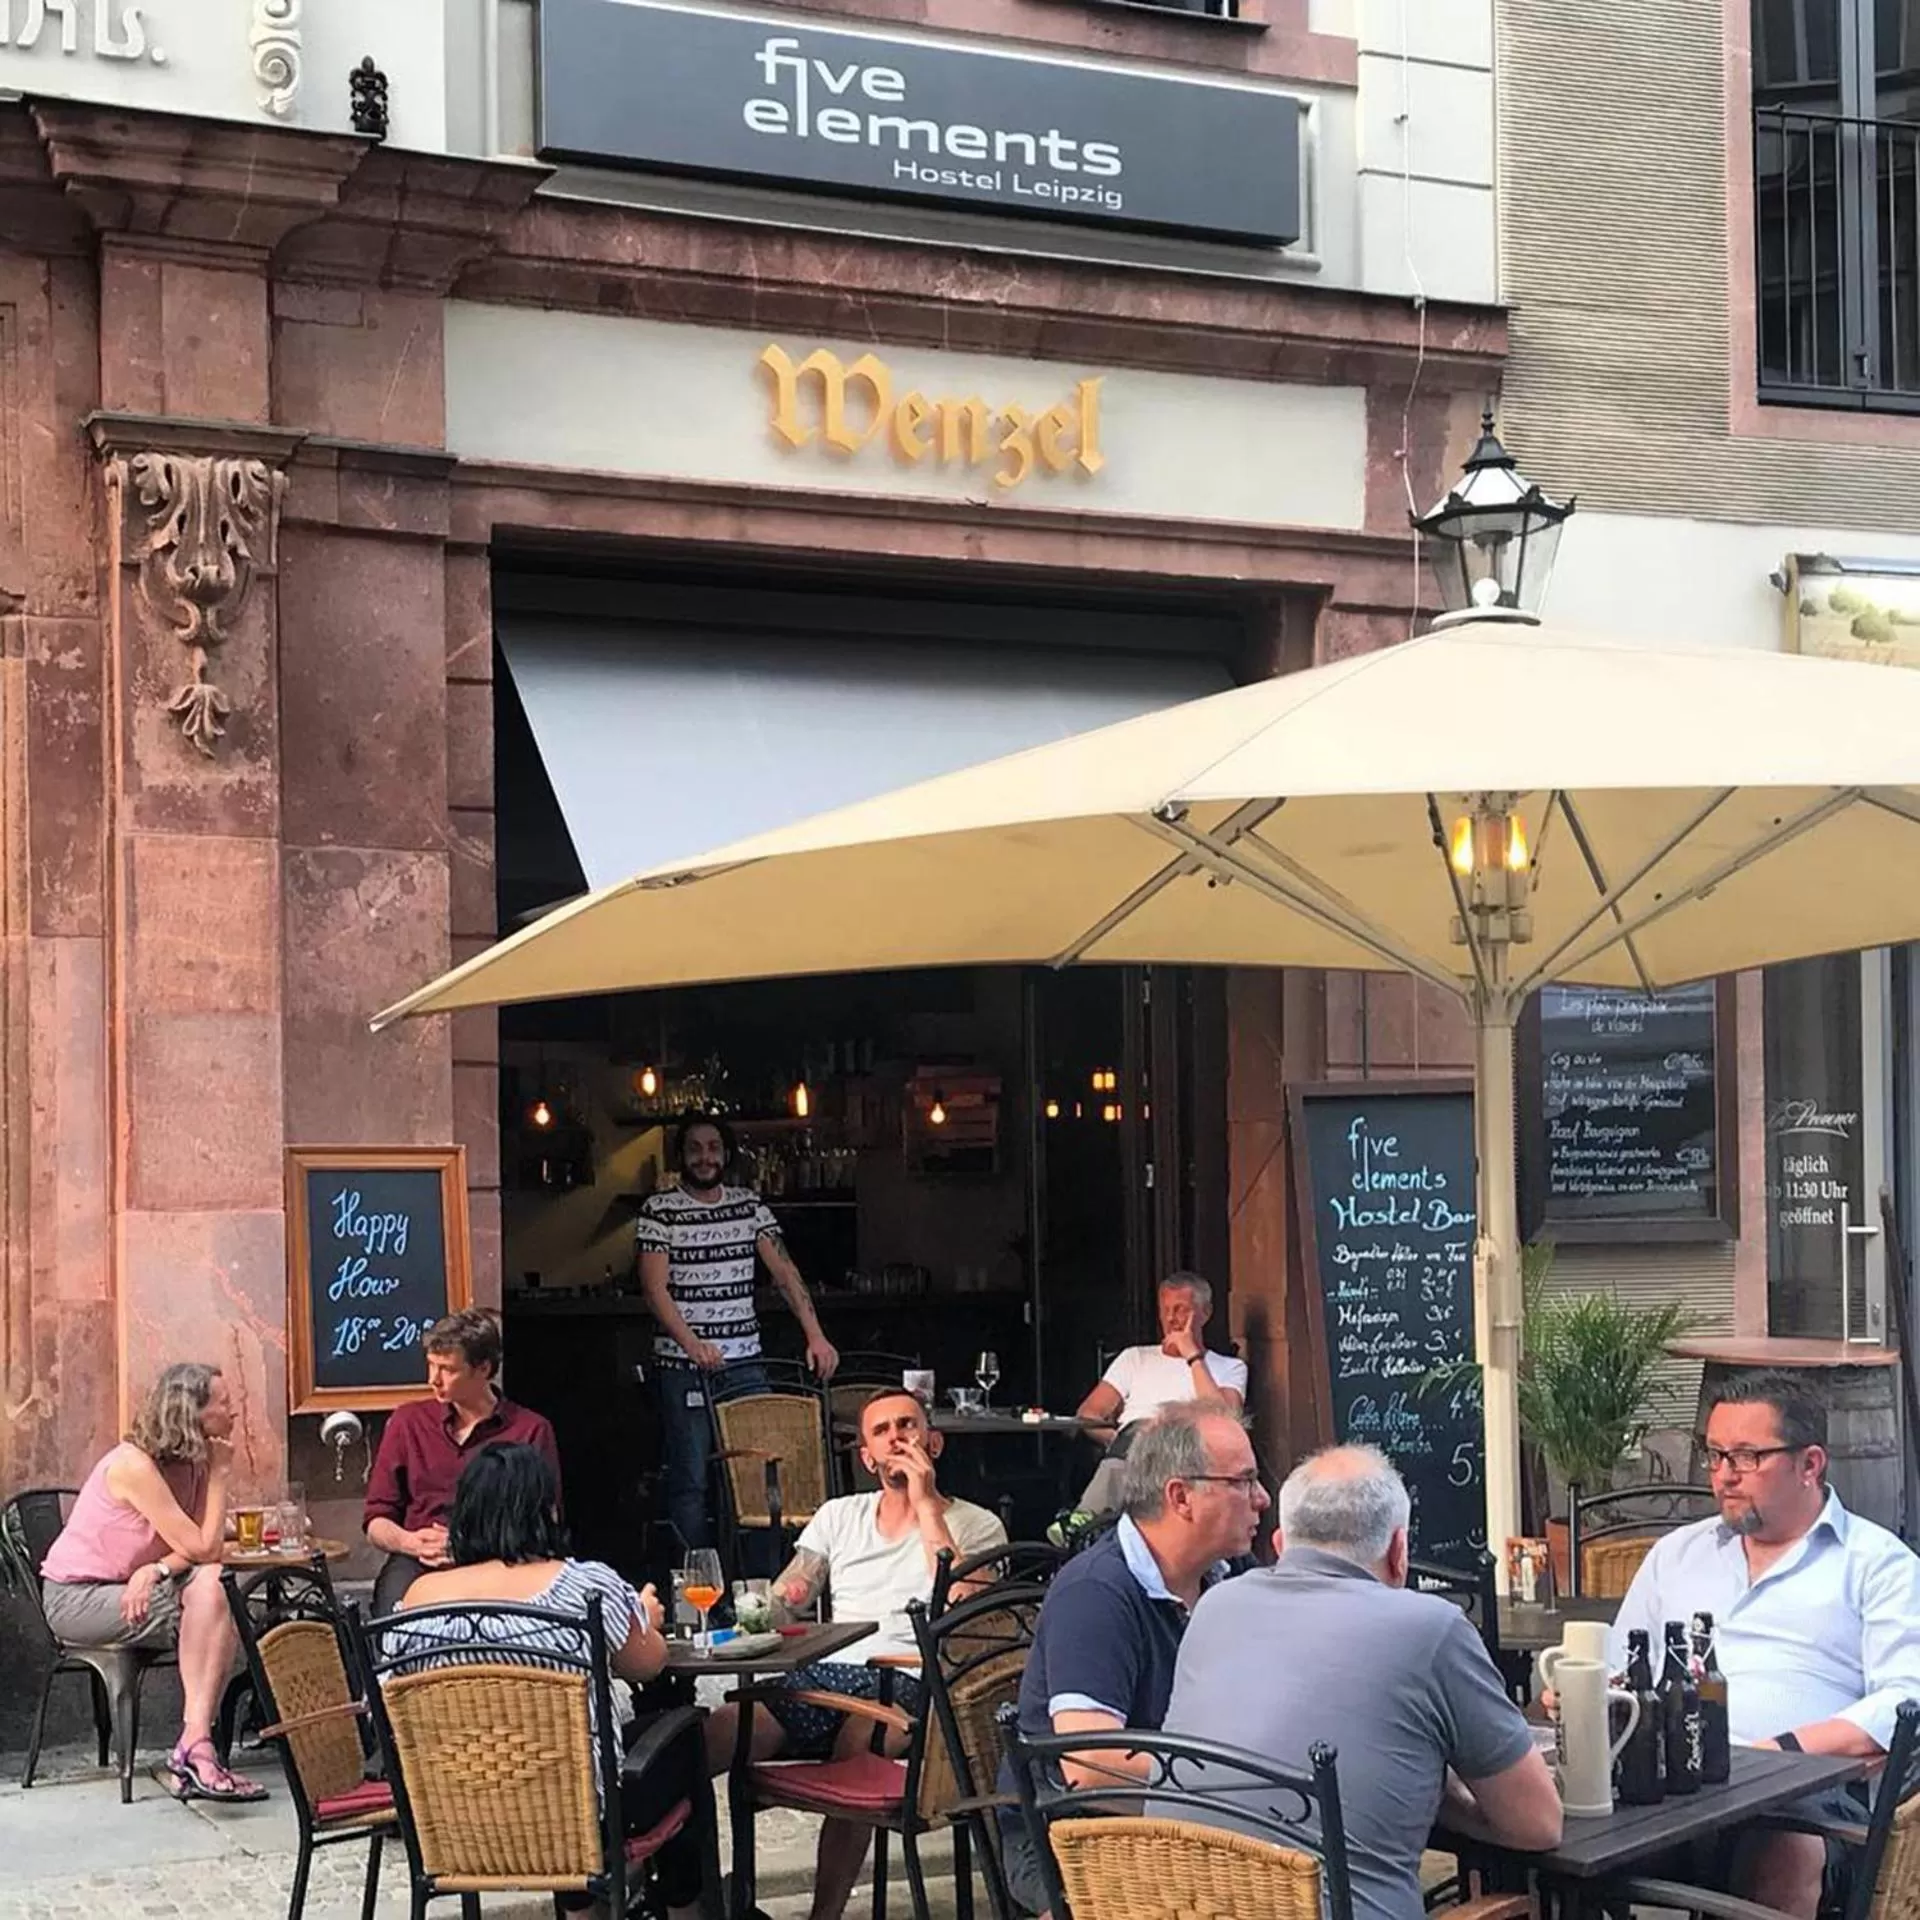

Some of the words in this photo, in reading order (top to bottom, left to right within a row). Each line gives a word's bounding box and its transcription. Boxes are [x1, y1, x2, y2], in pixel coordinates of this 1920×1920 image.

[754, 37, 906, 106] five
[743, 97, 1123, 177] elements
[893, 159, 1002, 191] Hostel
[1013, 173, 1123, 211] Leipzig
[760, 343, 1105, 488] Wenzel
[1348, 1116, 1399, 1161] five
[1351, 1164, 1447, 1193] elements
[1783, 1155, 1829, 1178] täglich
[1786, 1181, 1818, 1199] 11:30
[1821, 1180, 1849, 1199] Uhr
[331, 1187, 410, 1257] Happy
[1329, 1195, 1421, 1232] Hostel
[1422, 1199, 1477, 1232] Bar
[1779, 1206, 1835, 1229] geöffnet
[670, 1246, 707, 1261] LIVE
[328, 1255, 400, 1302] Hour
